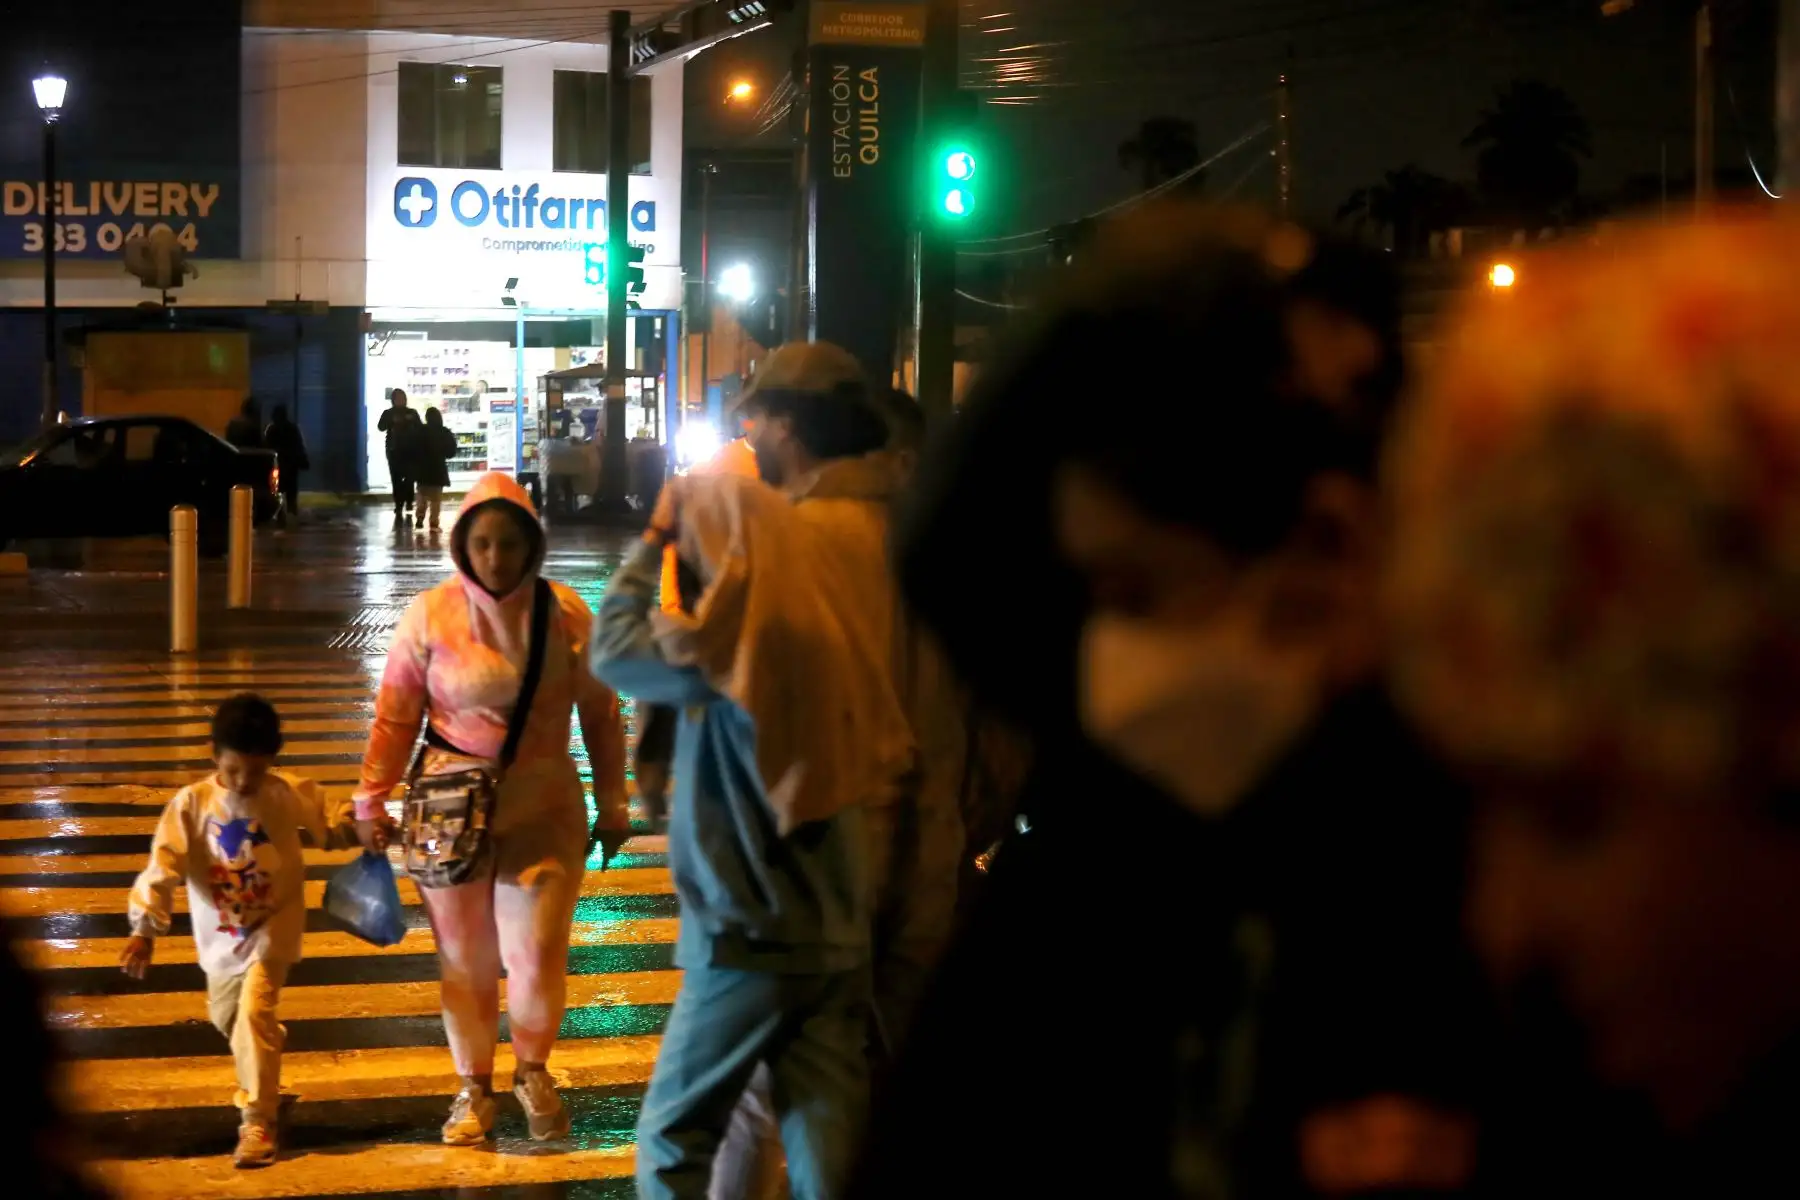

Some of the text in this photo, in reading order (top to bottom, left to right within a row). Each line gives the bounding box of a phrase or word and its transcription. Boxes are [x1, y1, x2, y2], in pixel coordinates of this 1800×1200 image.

[839, 12, 904, 26] CORREDOR
[829, 64, 851, 178] ESTACIÓN
[859, 66, 879, 165] QUILCA
[3, 181, 220, 217] DELIVERY
[450, 180, 656, 232] Otifarma
